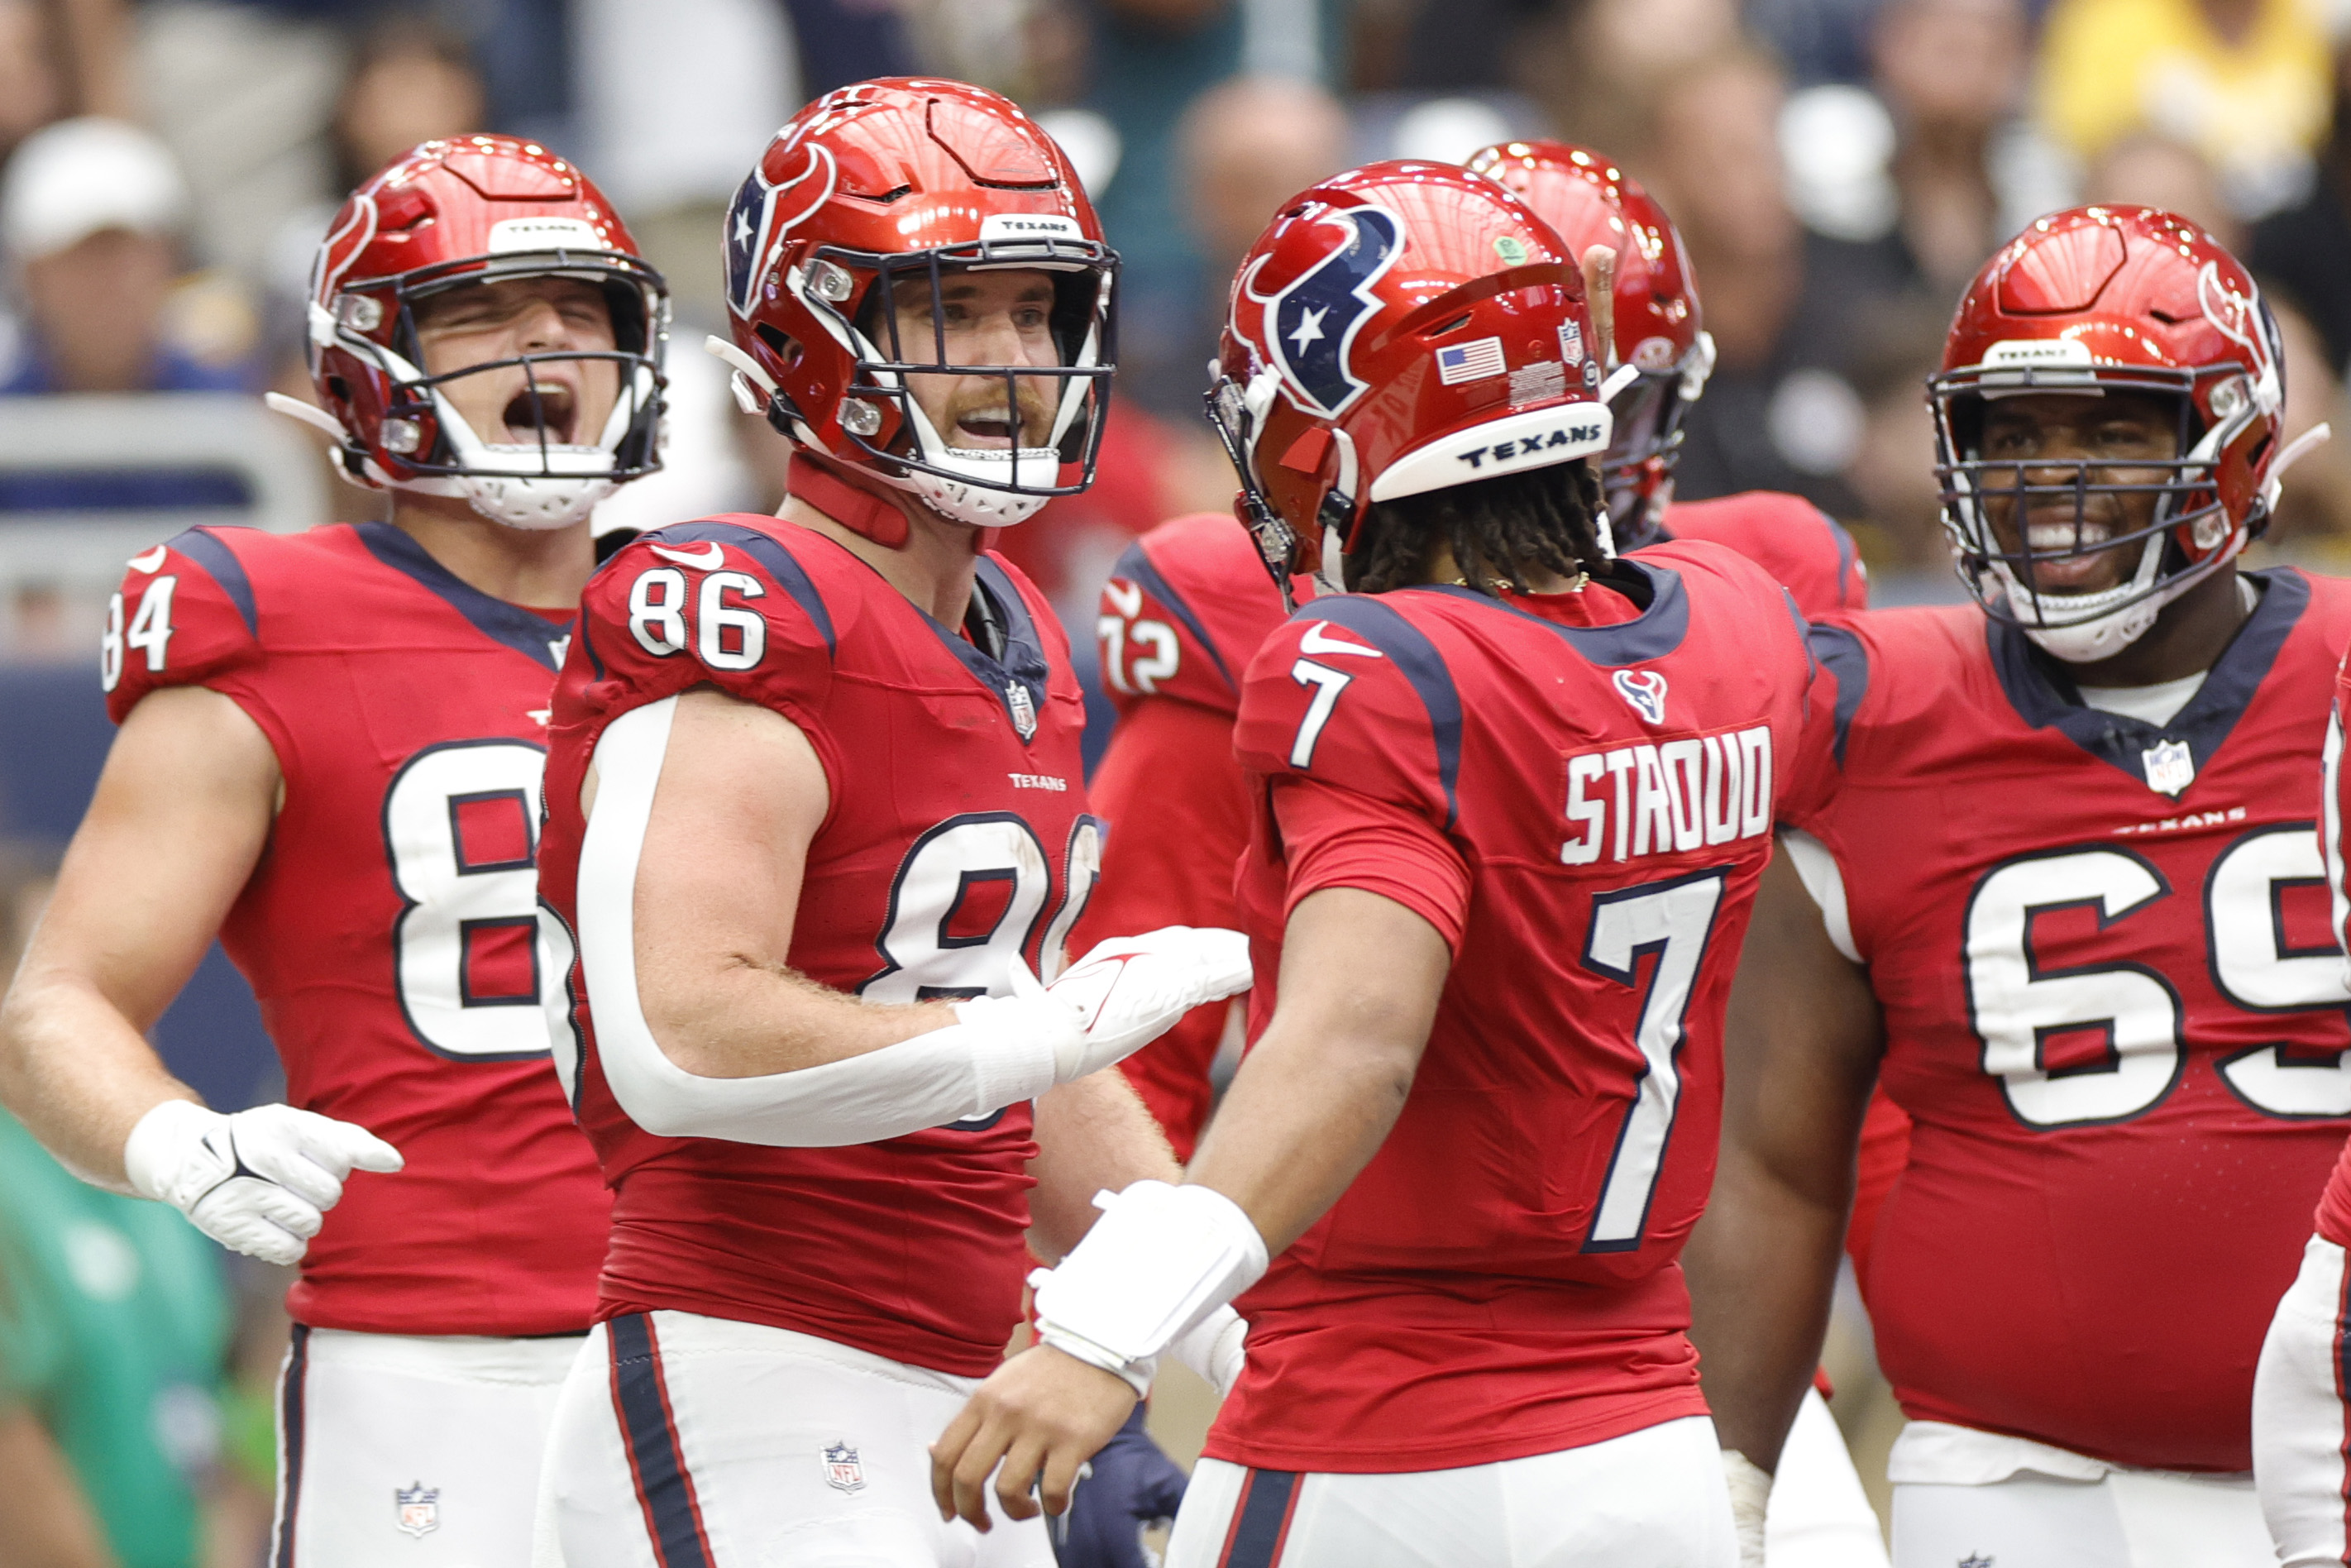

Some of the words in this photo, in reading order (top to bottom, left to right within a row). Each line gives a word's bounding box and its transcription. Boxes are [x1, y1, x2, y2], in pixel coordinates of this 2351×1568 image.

[1001, 221, 1068, 232] TEXANS
[1456, 424, 1602, 468] TEXANS
[101, 574, 179, 693] 84
[628, 564, 767, 672] 86
[1289, 656, 1356, 771] 7
[1007, 773, 1068, 792] TEXANS
[1560, 724, 1772, 866] STROUD
[1962, 821, 2351, 1133] 69
[1579, 863, 1737, 1254] 7
